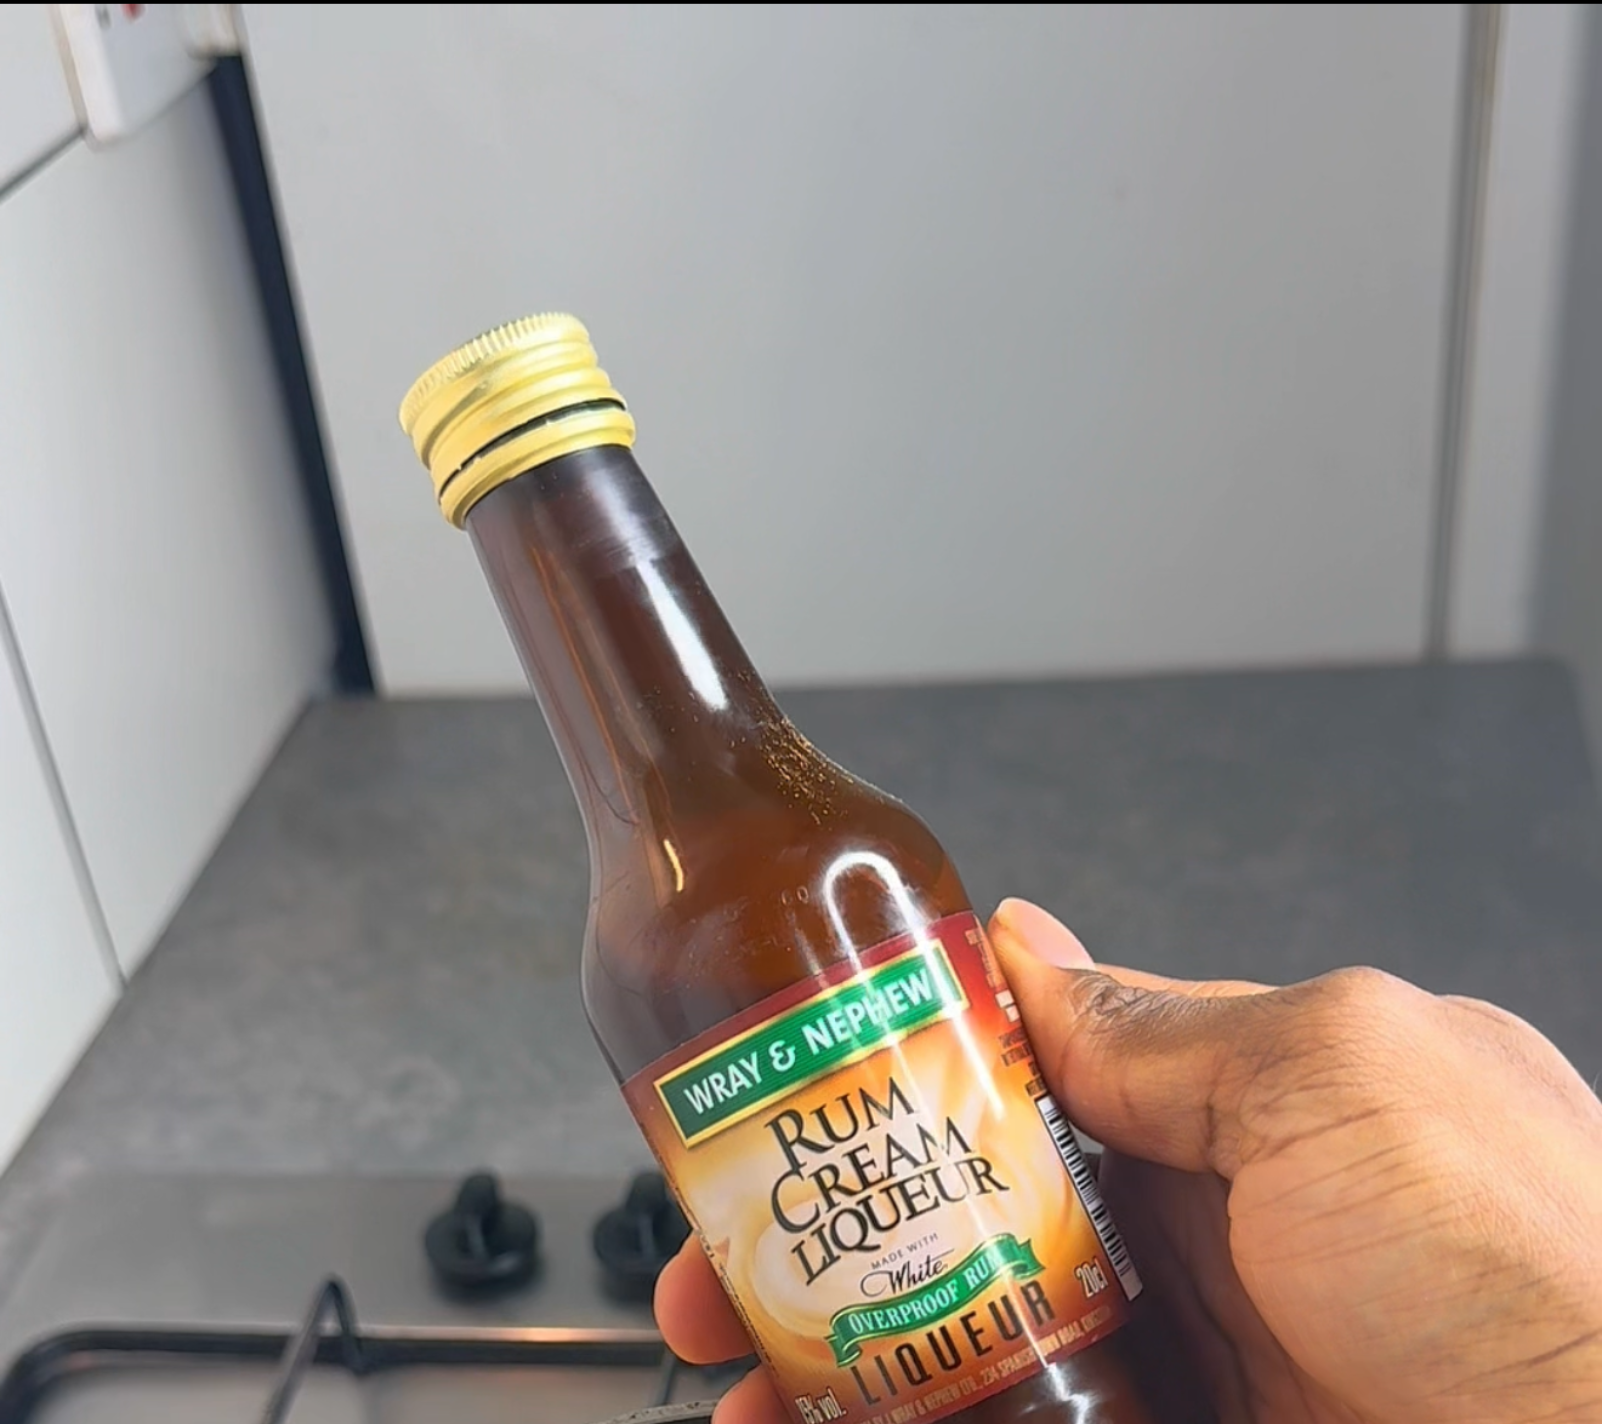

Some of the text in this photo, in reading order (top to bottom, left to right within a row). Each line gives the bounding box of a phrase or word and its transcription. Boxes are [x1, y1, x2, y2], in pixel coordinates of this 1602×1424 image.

[684, 1051, 762, 1115] WRAY
[768, 1039, 796, 1072] &
[801, 968, 934, 1056] NEPHEW
[764, 1076, 916, 1182] RUM
[770, 1116, 974, 1234] CREAM
[790, 1156, 1011, 1287] LIQUEUR
[871, 1232, 939, 1270] MADE WITH
[847, 1278, 960, 1335] OVERPROOF
[860, 1247, 955, 1298] White
[1074, 1256, 1109, 1299] 20cl
[850, 1279, 1056, 1406] LIQUEUR
[914, 1398, 927, 1416] &
